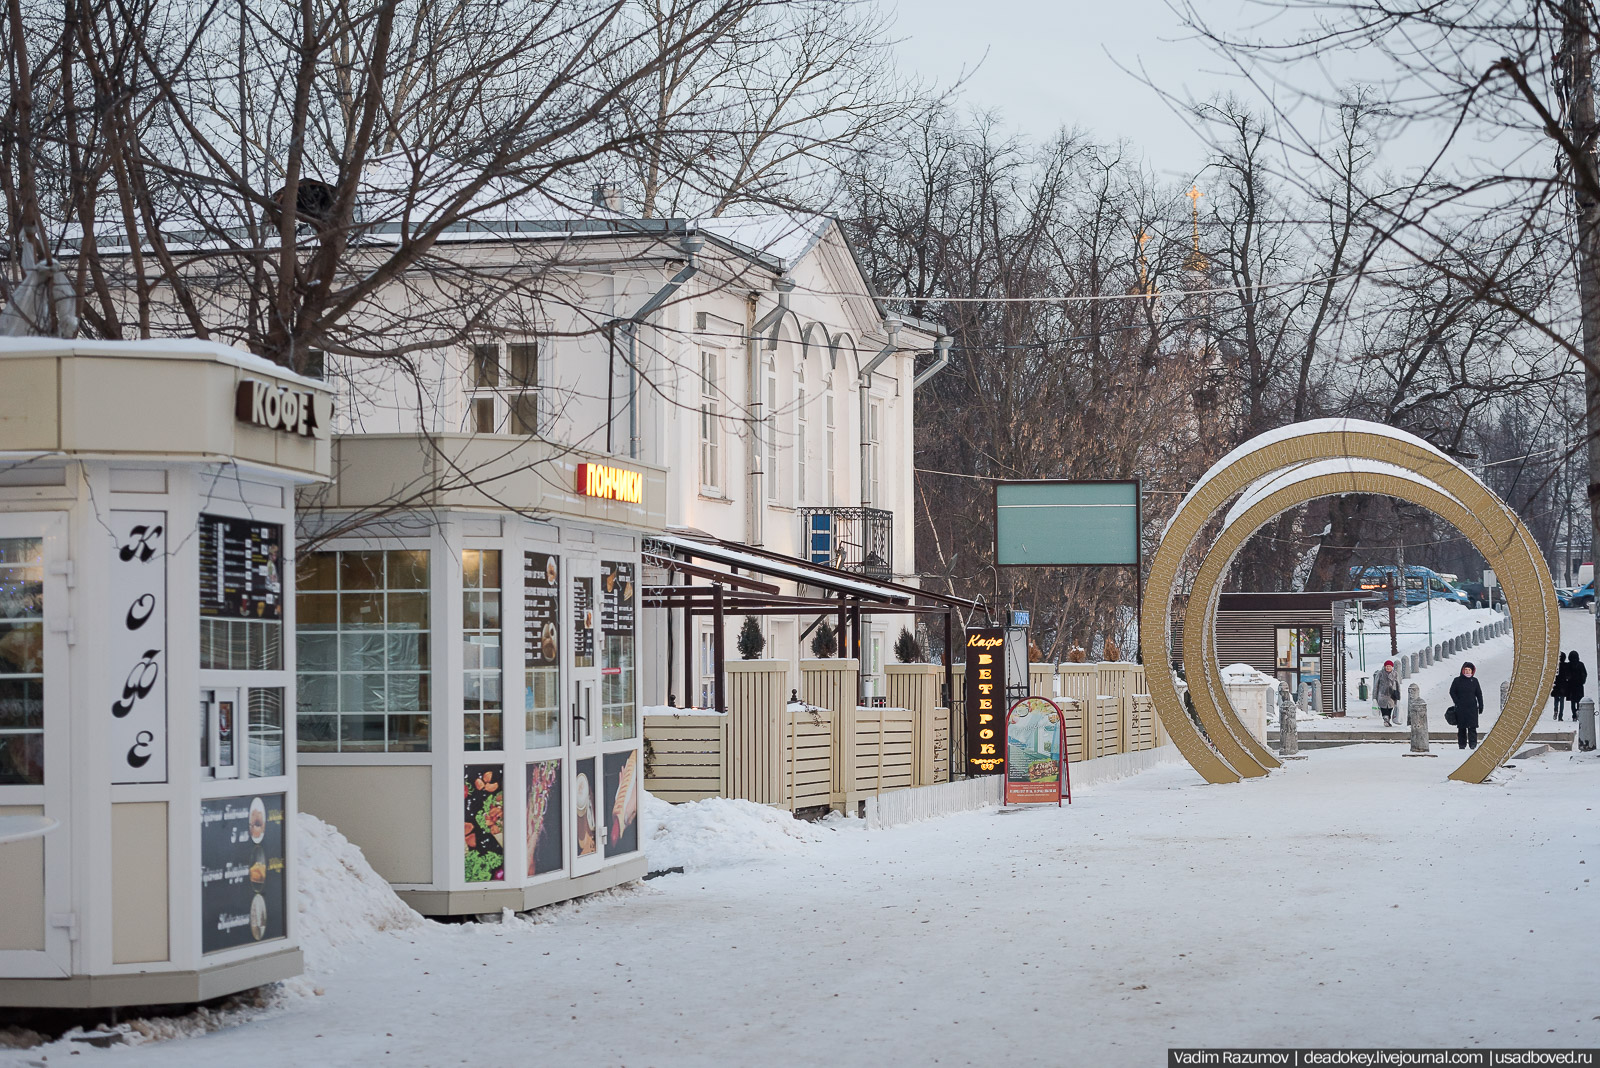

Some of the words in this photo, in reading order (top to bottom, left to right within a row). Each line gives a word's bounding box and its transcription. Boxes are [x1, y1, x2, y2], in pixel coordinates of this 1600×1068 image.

[252, 380, 309, 436] КОФЕ
[586, 463, 643, 504] ПОНЧИКИ
[967, 634, 1004, 650] Кафе
[978, 654, 996, 755] ВЕТЕРОК
